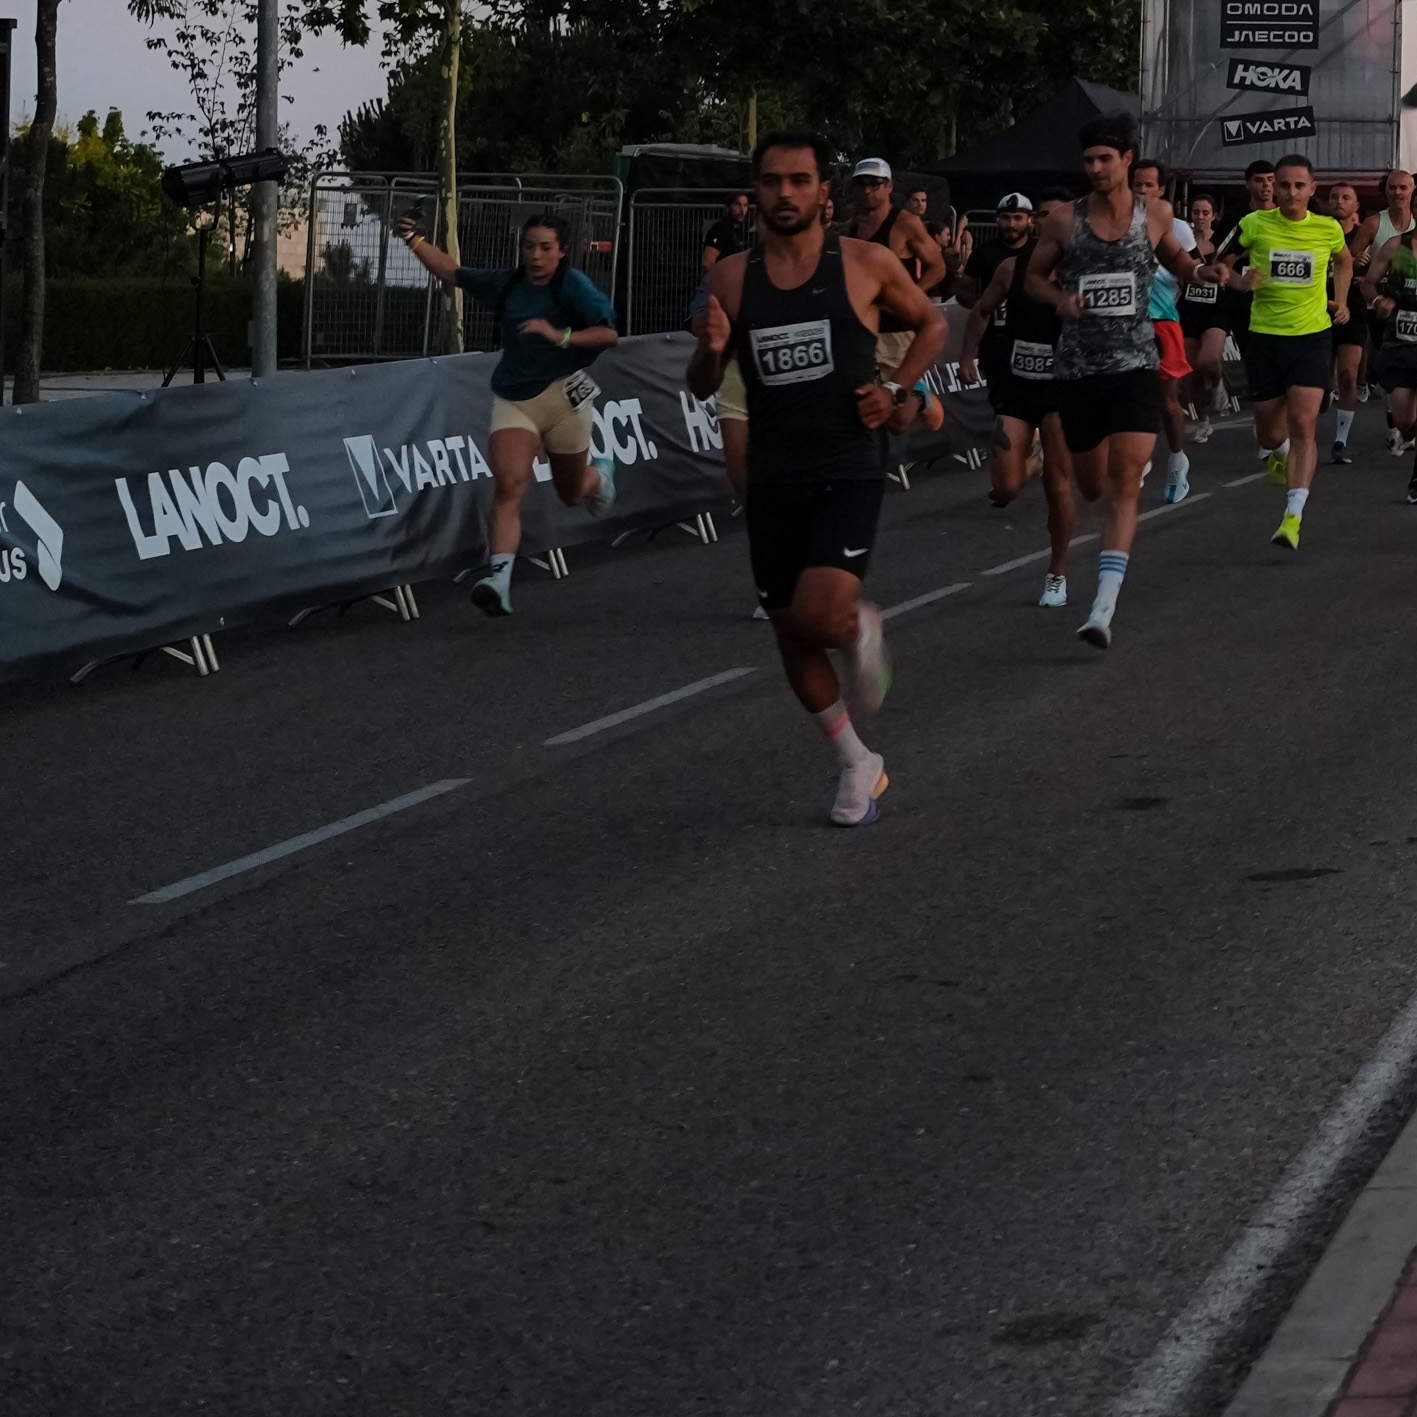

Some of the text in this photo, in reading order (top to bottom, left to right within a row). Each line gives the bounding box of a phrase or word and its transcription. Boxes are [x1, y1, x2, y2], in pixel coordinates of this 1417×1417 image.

[1226, 2, 1314, 17] OMODA
[1226, 29, 1314, 43] JAECOO
[1232, 64, 1302, 90] HOKA
[1245, 115, 1312, 136] VARTA
[1277, 262, 1305, 276] 666
[1085, 287, 1131, 308] 1285
[762, 342, 825, 372] 1866
[384, 434, 492, 493] VARTA
[114, 452, 310, 560] LANOCT.
